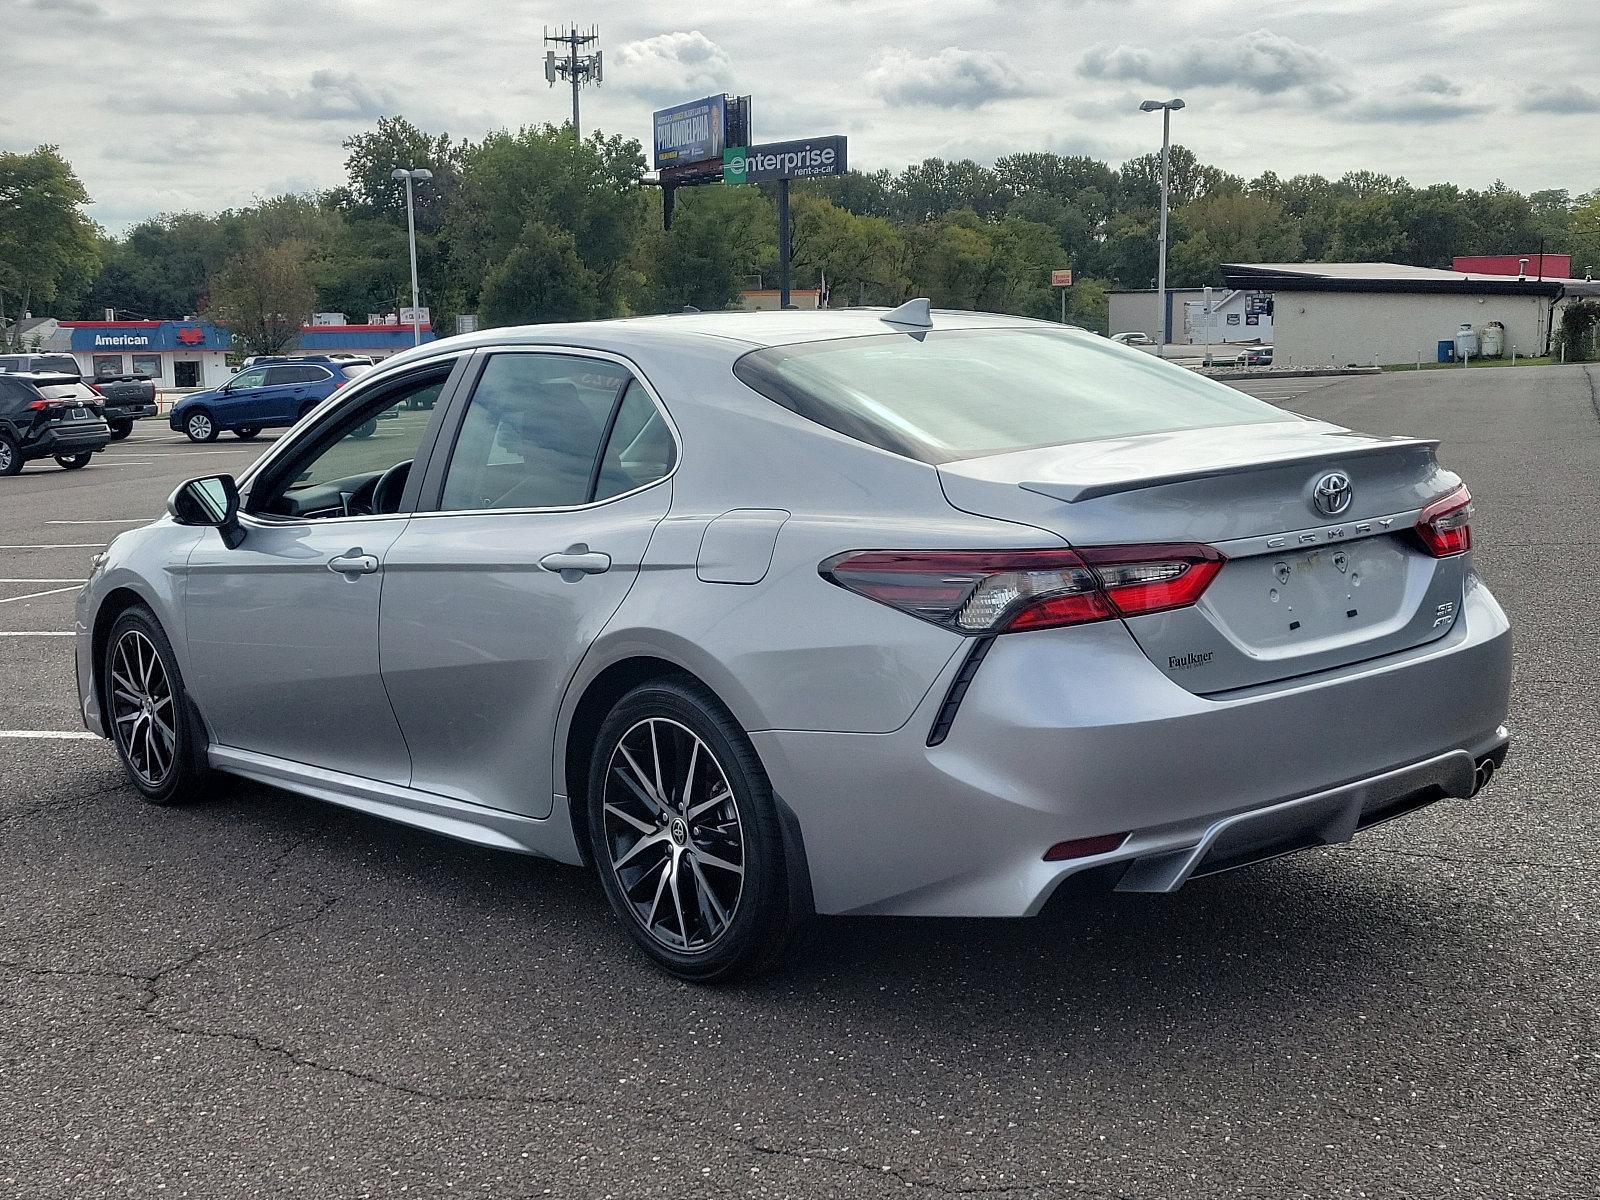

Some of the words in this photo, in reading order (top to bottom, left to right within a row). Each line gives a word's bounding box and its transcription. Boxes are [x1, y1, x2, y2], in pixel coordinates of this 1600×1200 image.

[730, 145, 835, 174] enterprise
[794, 164, 835, 176] rent-a-car
[95, 334, 149, 346] American
[1266, 518, 1394, 549] CAMRY
[1168, 651, 1213, 668] Faulkner
